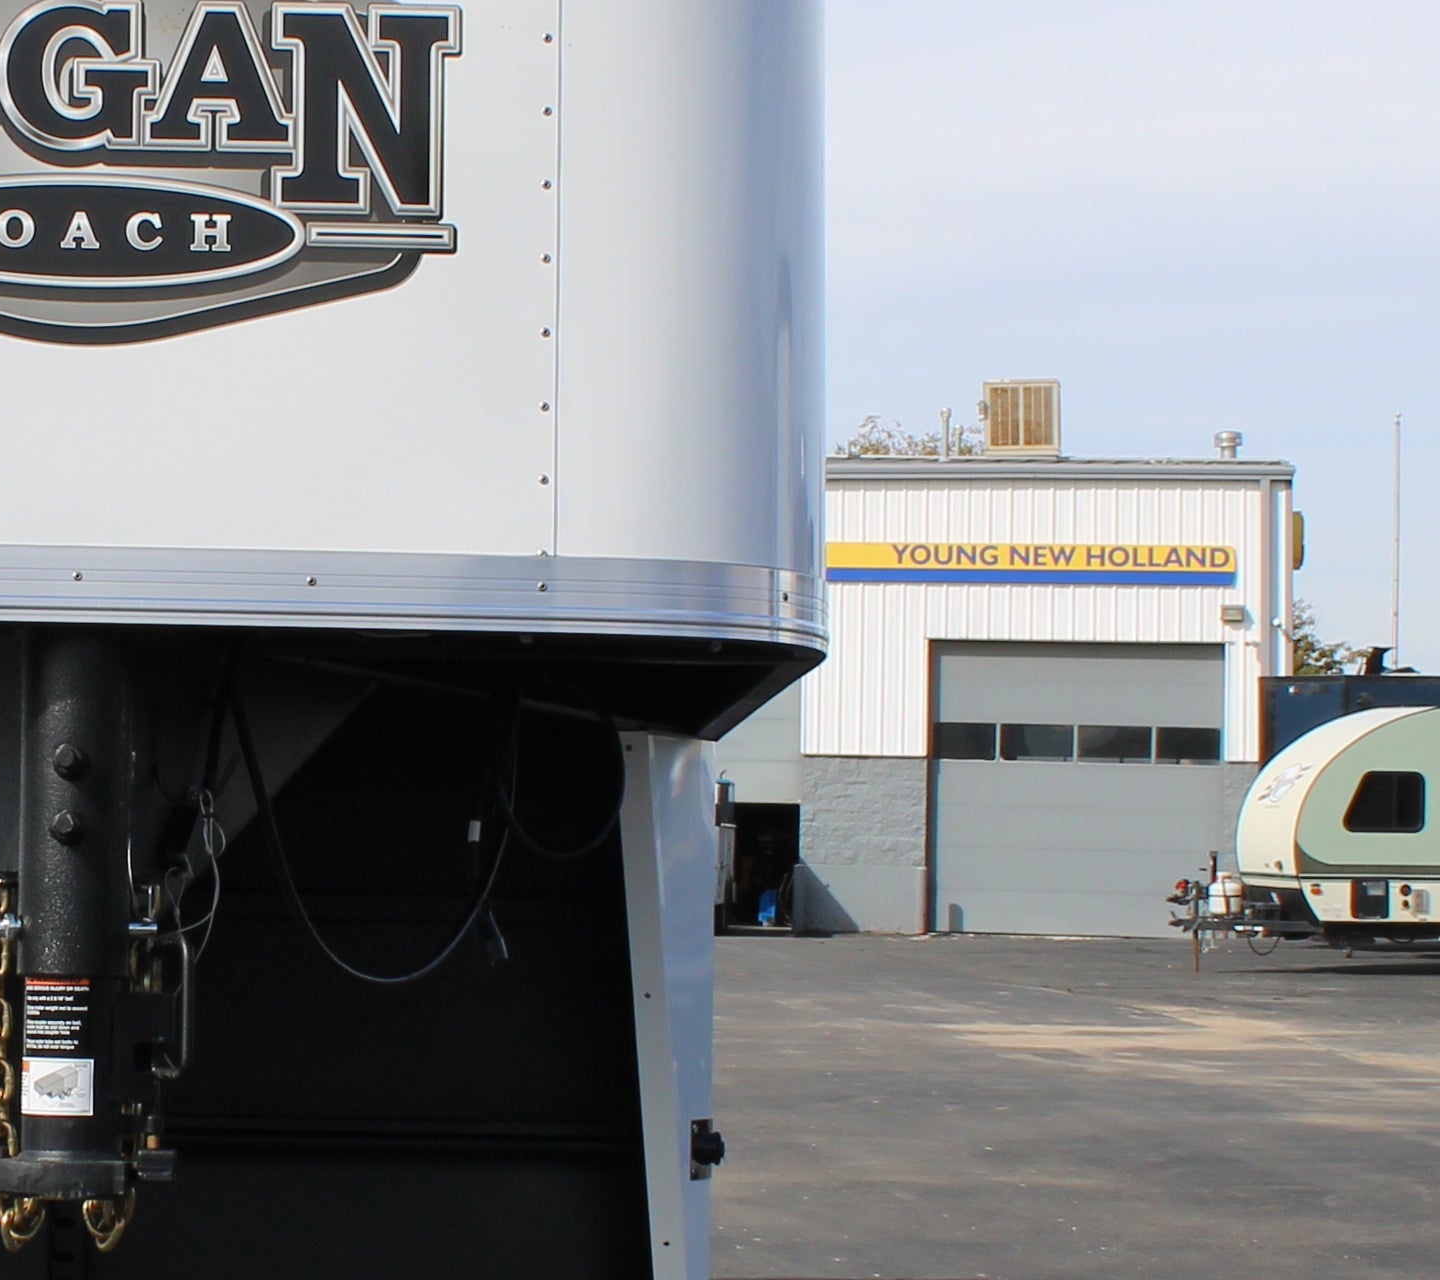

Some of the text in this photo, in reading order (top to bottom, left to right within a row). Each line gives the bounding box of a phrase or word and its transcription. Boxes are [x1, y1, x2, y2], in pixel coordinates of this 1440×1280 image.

[891, 544, 1230, 569] YOUNG NEW HOLLAND
